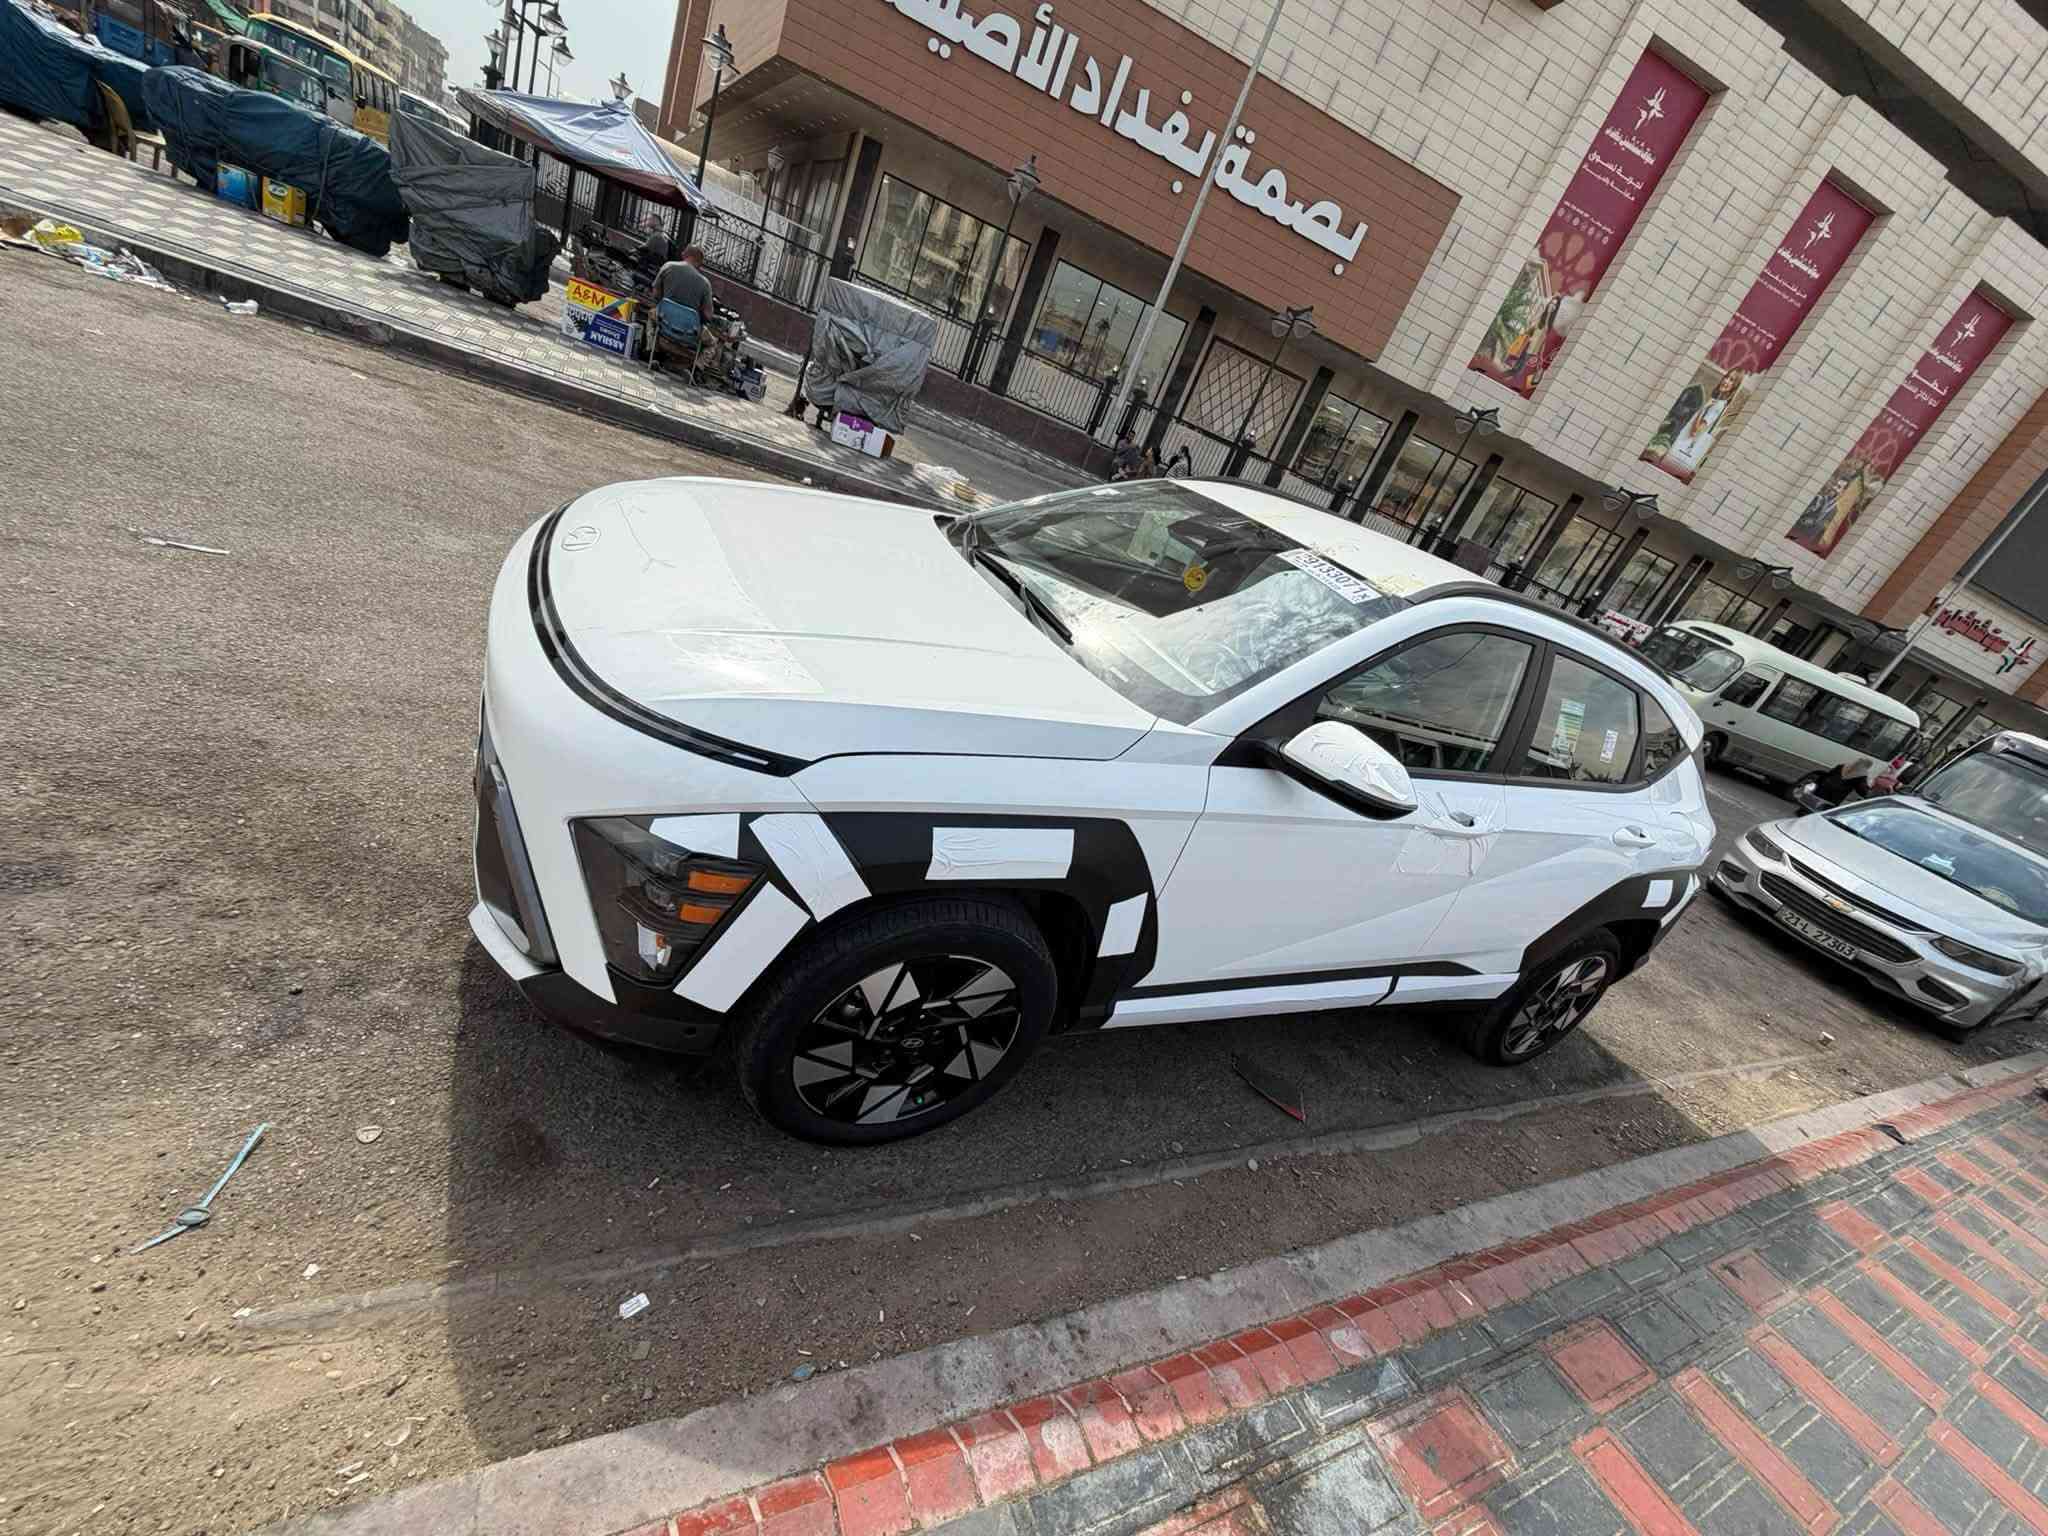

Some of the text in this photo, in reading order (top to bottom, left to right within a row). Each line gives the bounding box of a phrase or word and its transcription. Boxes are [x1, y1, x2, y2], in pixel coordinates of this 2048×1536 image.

[1070, 54, 1217, 194] بغداد
[1214, 125, 1369, 276] بصمة
[572, 285, 607, 308] A&M
